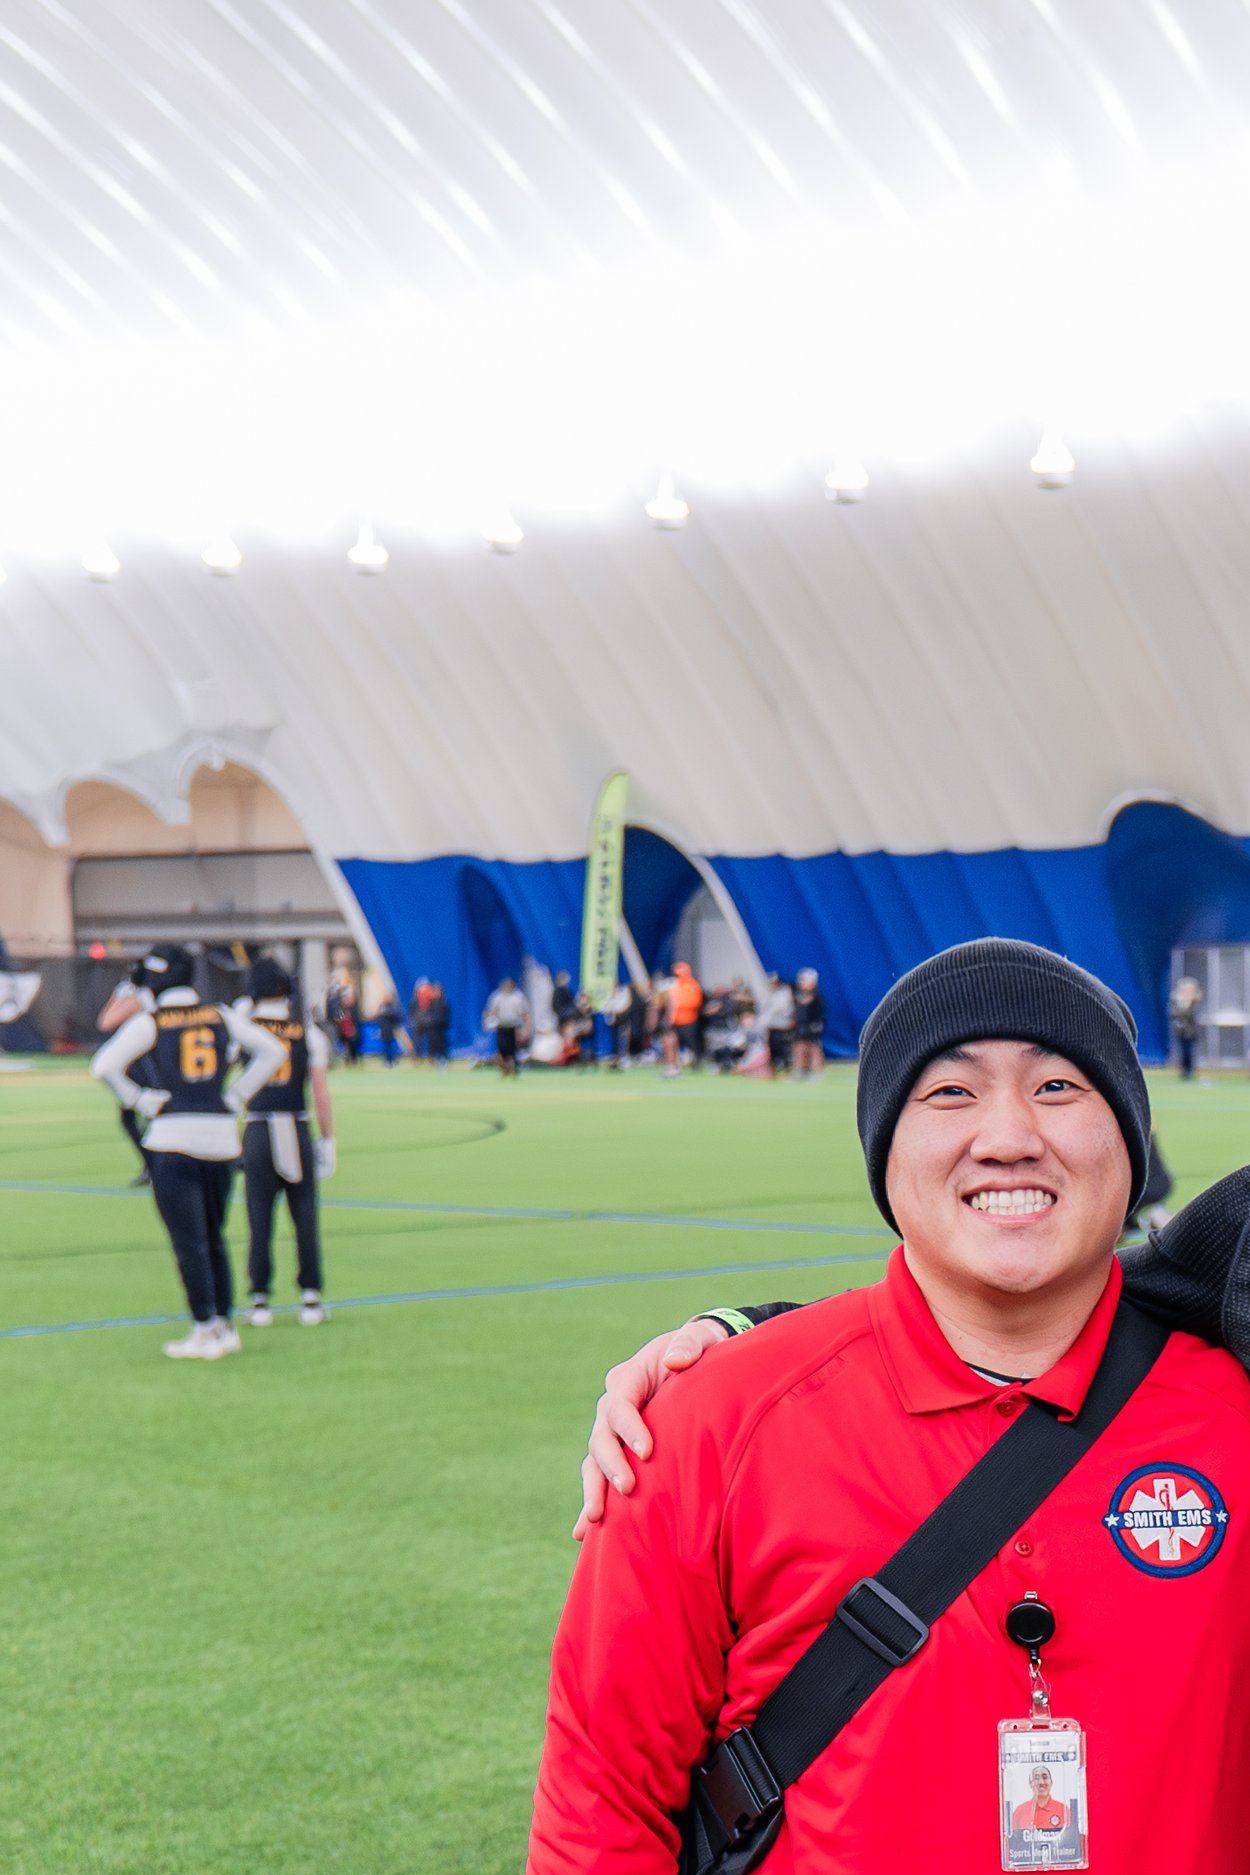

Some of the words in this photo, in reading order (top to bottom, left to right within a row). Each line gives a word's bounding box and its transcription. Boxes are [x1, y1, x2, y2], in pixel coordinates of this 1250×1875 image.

[181, 1028, 217, 1082] 6
[1123, 1511, 1173, 1528] SMITH
[1177, 1509, 1212, 1526] EMS
[1009, 1848, 1031, 1859] Sports
